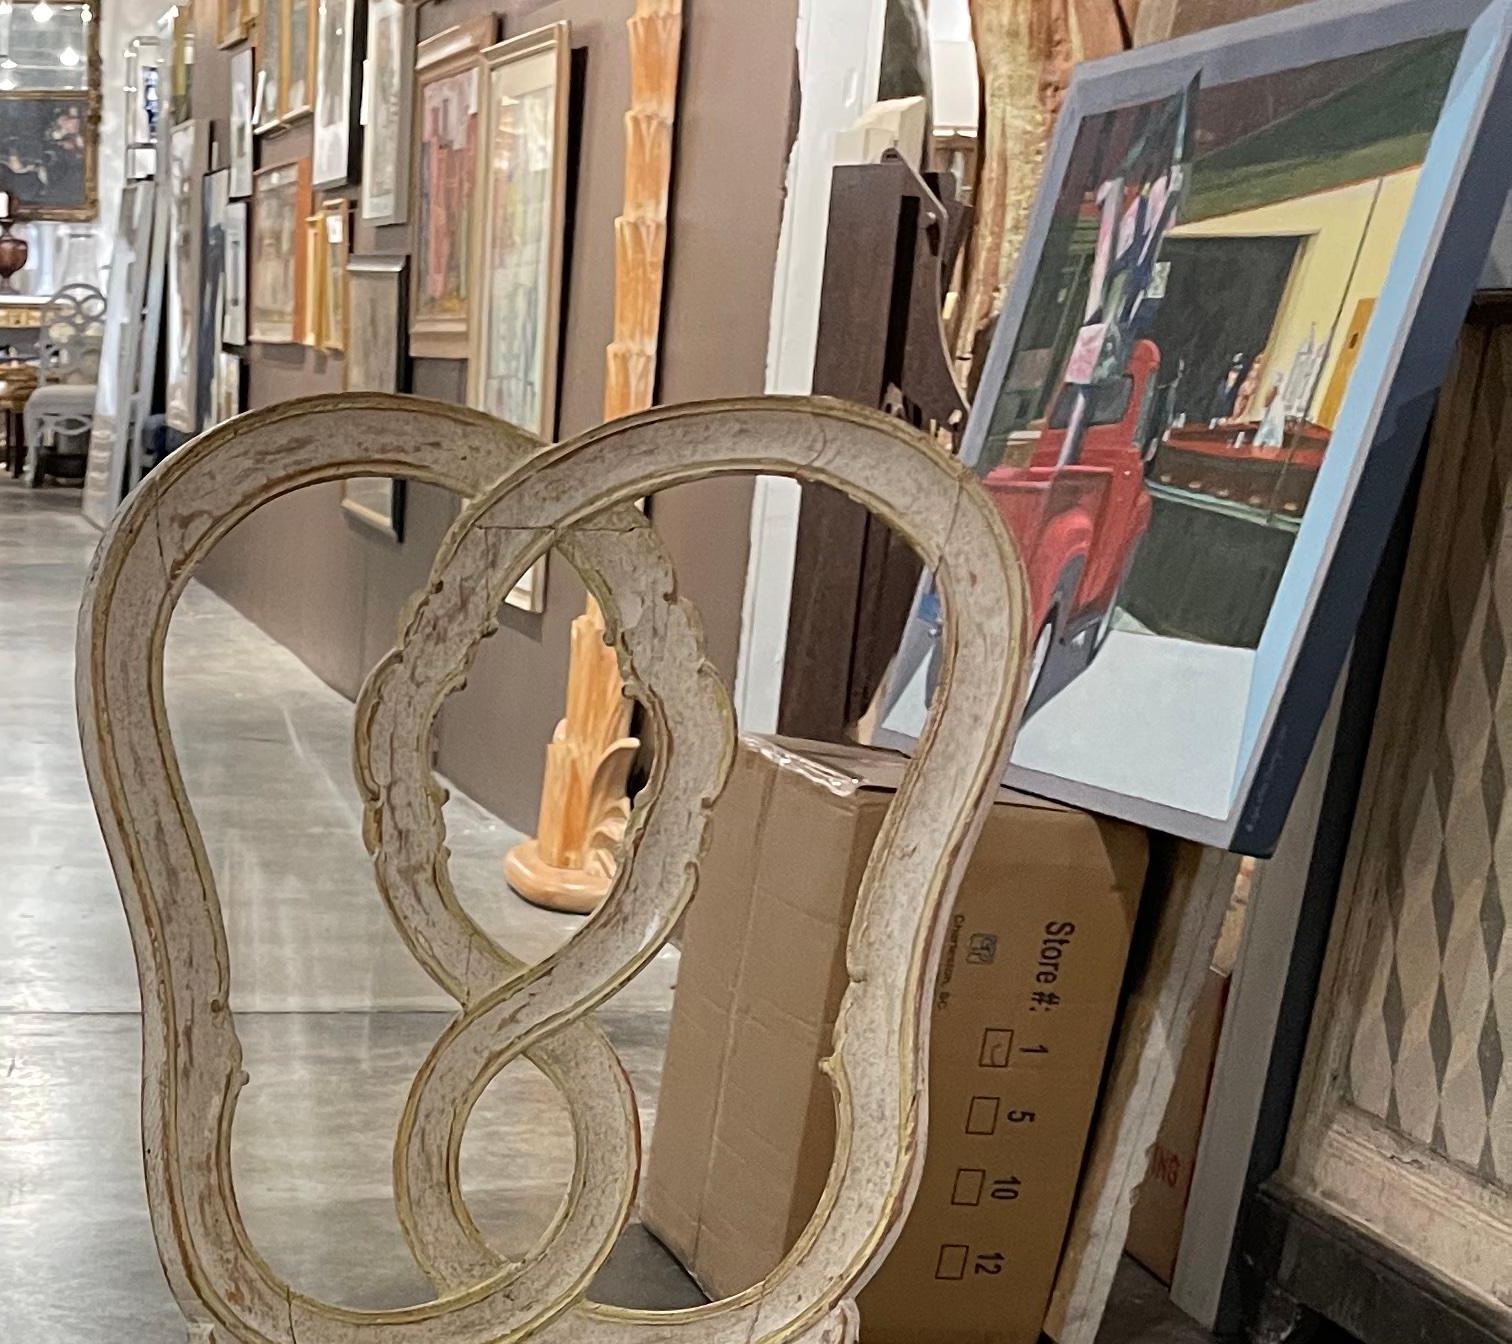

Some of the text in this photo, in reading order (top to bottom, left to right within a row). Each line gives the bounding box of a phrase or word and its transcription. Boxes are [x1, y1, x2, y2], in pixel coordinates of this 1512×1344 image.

[974, 921, 1075, 1274] Store #: 1 5 10 12
